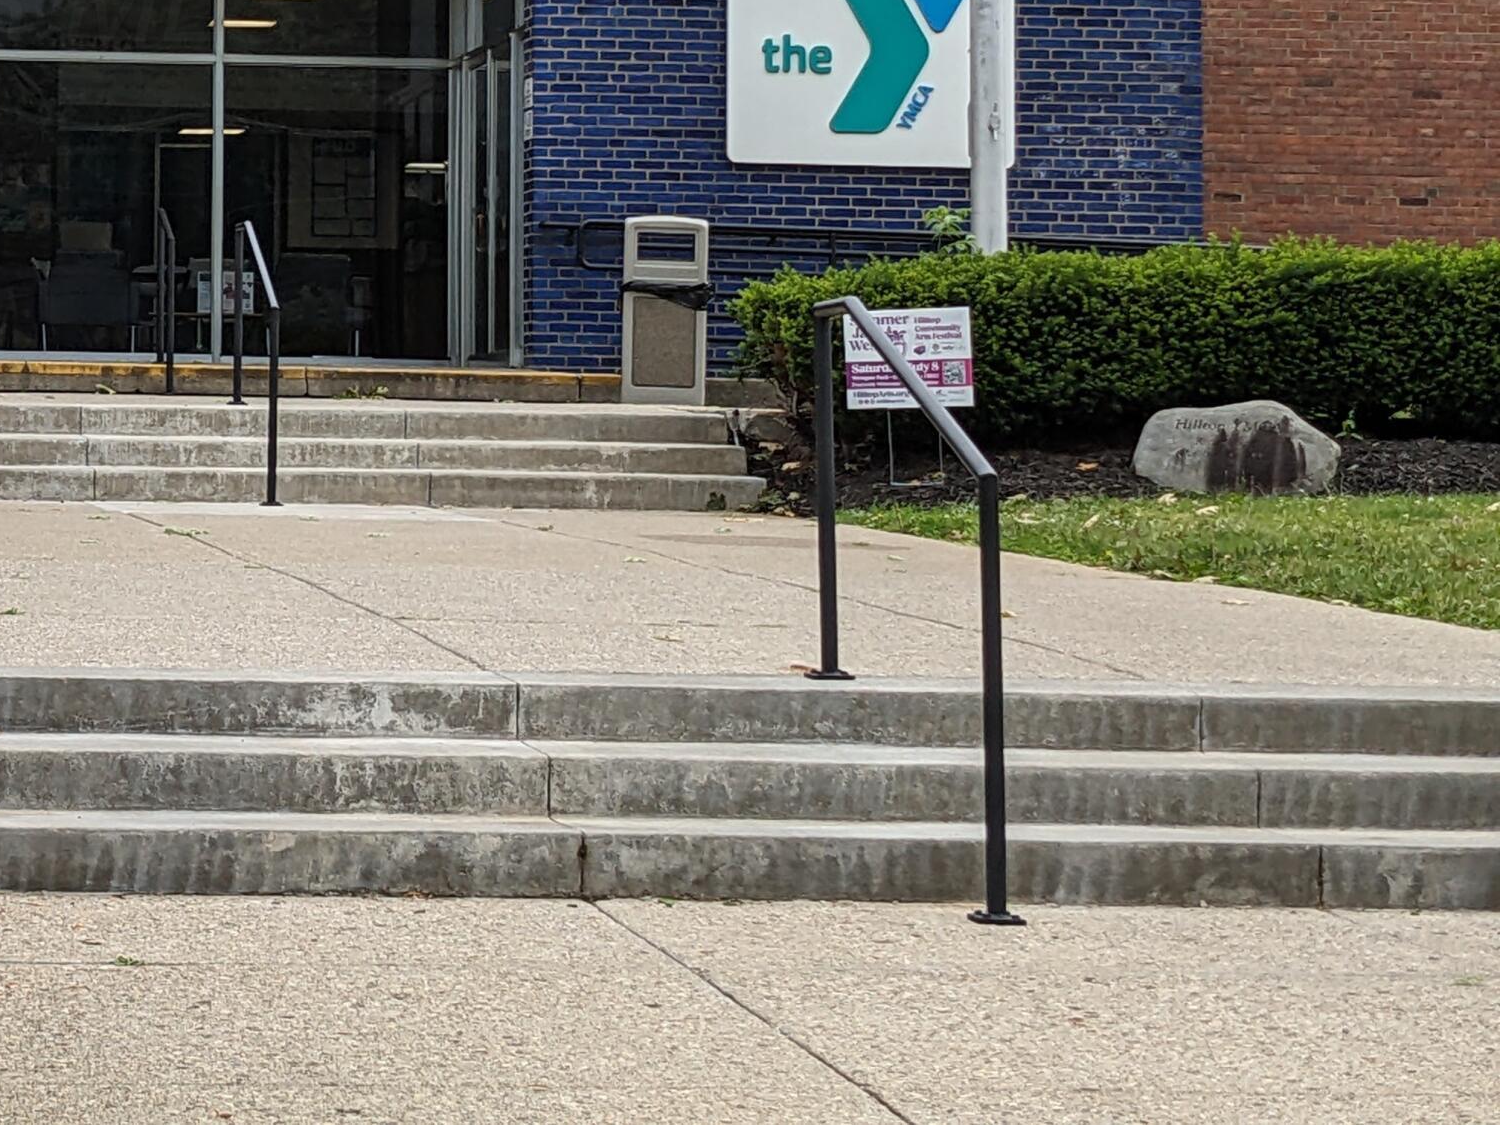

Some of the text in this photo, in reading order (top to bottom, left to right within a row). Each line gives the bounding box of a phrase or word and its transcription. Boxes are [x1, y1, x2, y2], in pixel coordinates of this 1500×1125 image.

[762, 34, 832, 74] the
[896, 85, 934, 130] YMCA
[851, 363, 894, 374] Saturd
